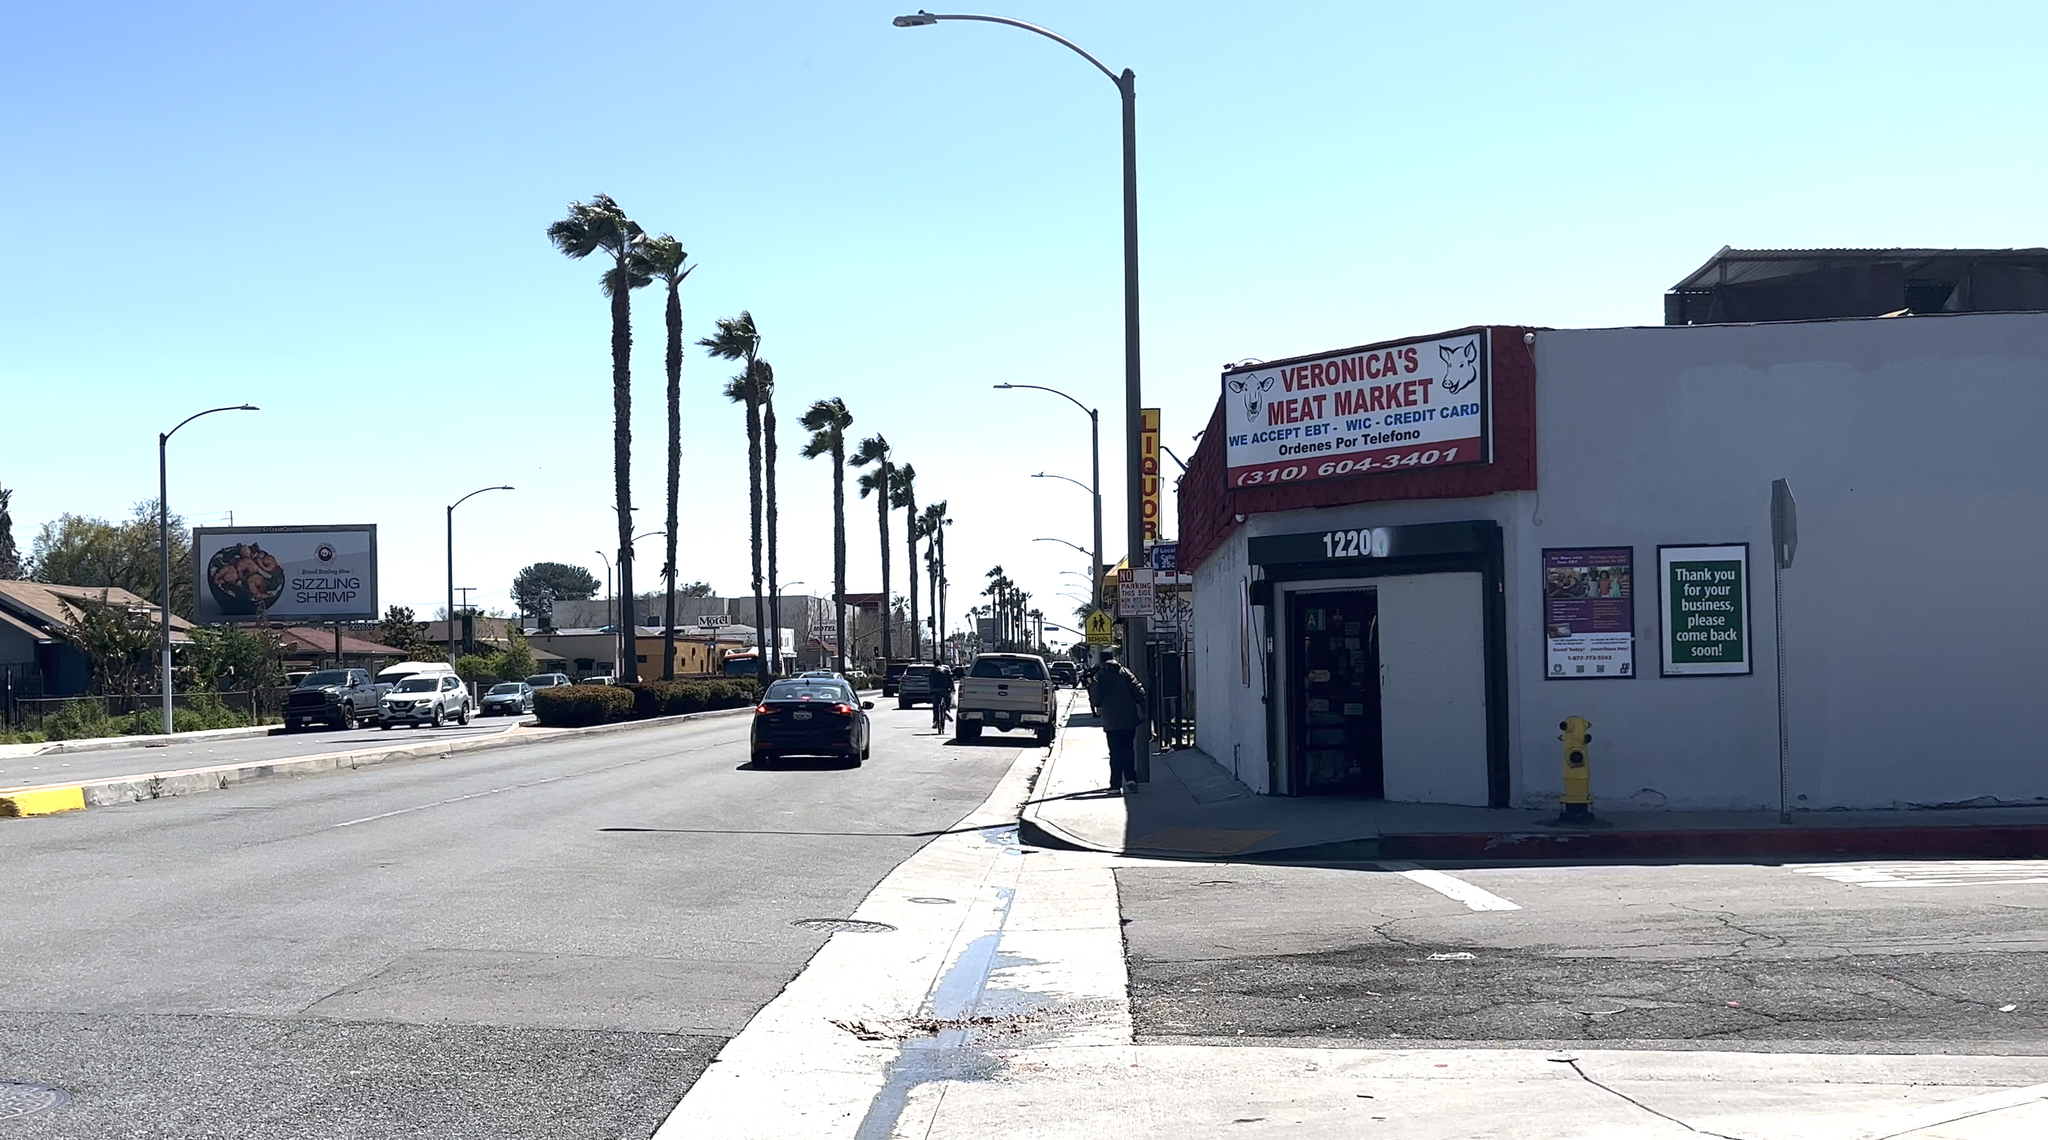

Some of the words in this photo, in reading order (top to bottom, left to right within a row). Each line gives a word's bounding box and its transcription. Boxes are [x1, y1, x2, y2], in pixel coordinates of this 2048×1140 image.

[1281, 348, 1419, 392] VERONICA'S
[1268, 395, 1327, 426] MEAT
[1334, 378, 1434, 416] MARKET
[1229, 434, 1248, 447] WE
[1251, 428, 1301, 444] ACCEPT
[1304, 423, 1331, 437] EBT
[1346, 417, 1372, 431] WIC
[1384, 408, 1437, 427] CREDIT
[1440, 402, 1480, 419] CARD
[1278, 440, 1332, 456] Ordenes
[1336, 436, 1359, 449] Por
[1361, 428, 1421, 446] Telefono
[1237, 466, 1308, 487] (310)
[1317, 447, 1459, 477] 604-3401
[1141, 415, 1157, 539] LIQUOR
[1120, 570, 1132, 581] NO
[1675, 568, 1712, 581] Thank
[1714, 570, 1736, 584] you
[291, 578, 361, 591] SIZZLING
[1683, 583, 1702, 596] for
[1704, 586, 1731, 599] your
[296, 591, 357, 604] SHRIMP
[1681, 598, 1735, 612] business,
[699, 616, 729, 626] Motel
[1308, 613, 1316, 626] A
[1687, 613, 1725, 629] please
[1088, 635, 1110, 643] SCHOOL
[1676, 631, 1708, 641] come
[1710, 628, 1738, 641] back
[1691, 643, 1722, 656] soon!
